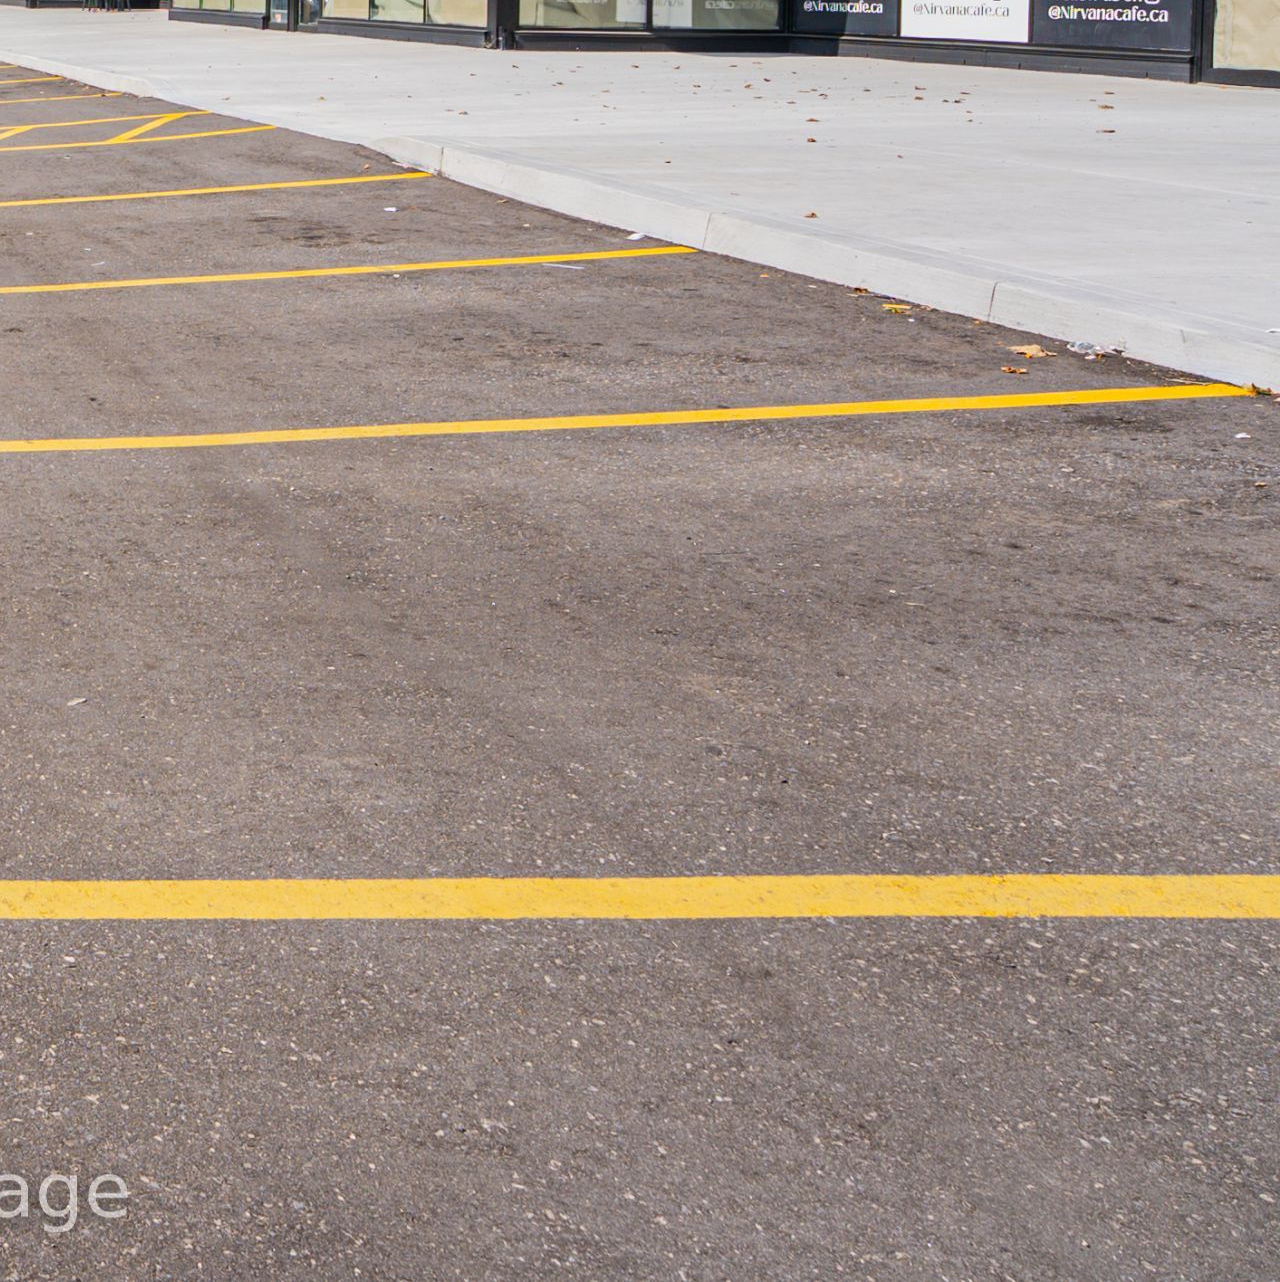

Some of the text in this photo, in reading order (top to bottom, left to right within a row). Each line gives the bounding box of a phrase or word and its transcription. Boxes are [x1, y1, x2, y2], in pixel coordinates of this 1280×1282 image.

[803, 0, 883, 14] @Nirvanacafe.ca
[913, 2, 1009, 18] @Nirvanacafe.ca
[1048, 5, 1169, 23] @Nirvanacafe.ca
